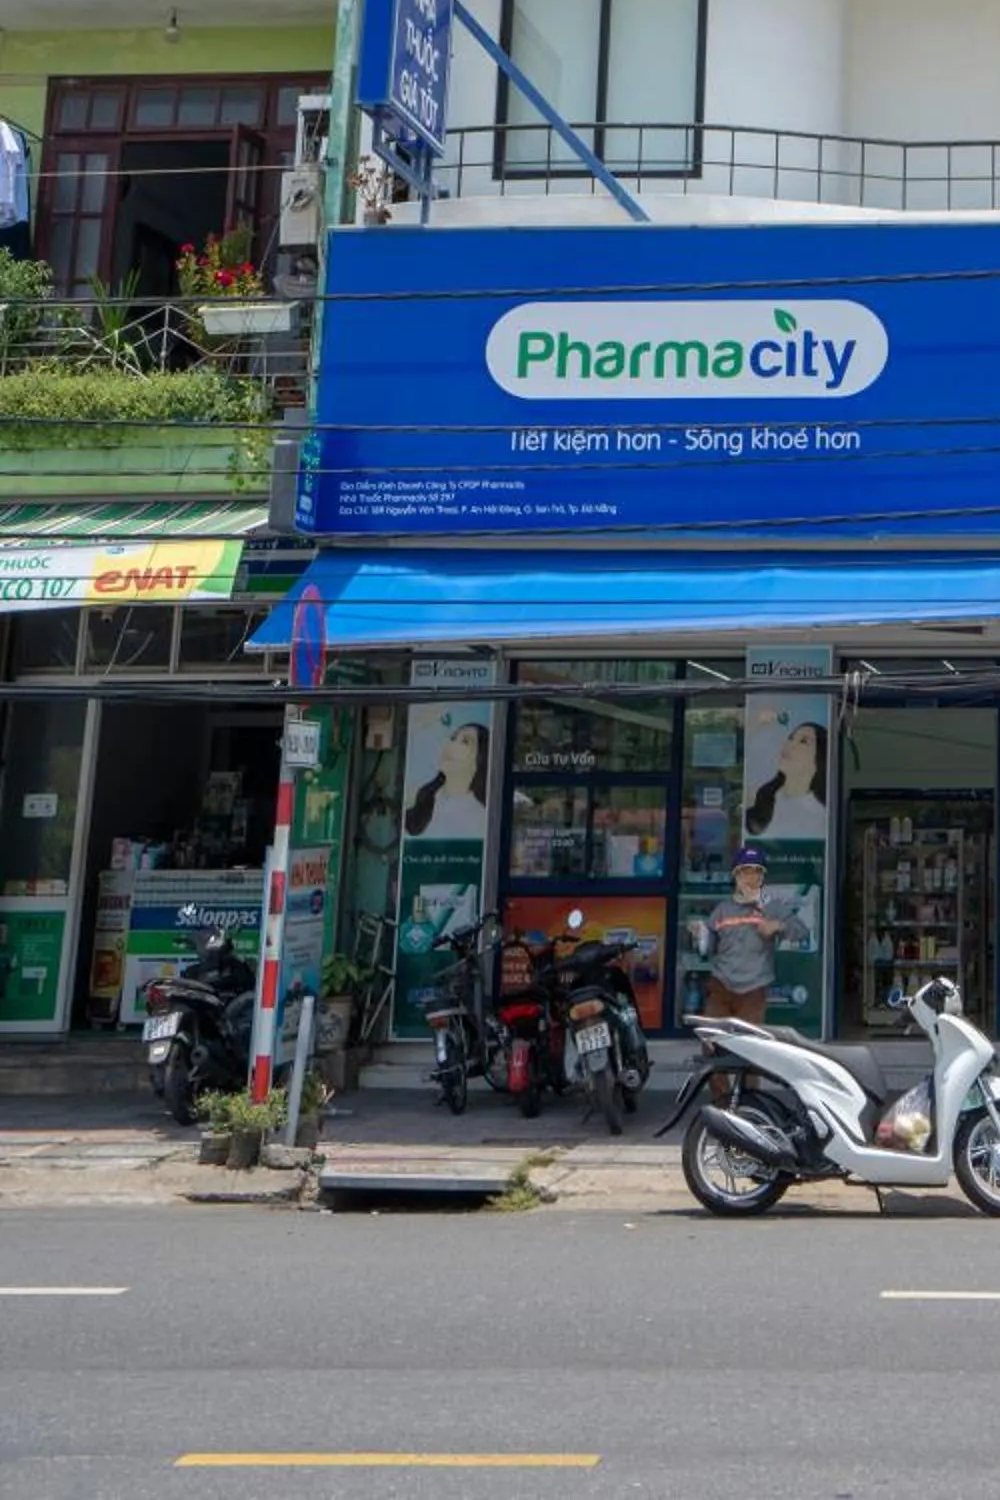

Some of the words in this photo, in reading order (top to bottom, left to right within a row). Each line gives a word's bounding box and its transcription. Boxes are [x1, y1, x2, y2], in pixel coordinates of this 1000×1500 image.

[405, 18, 439, 81] THUỐC
[400, 69, 418, 112] GIÁ
[420, 82, 439, 131] TỐT
[516, 328, 857, 389] Pharmacity
[554, 428, 610, 455] kiệm
[617, 429, 661, 451] hơn
[815, 427, 861, 450] hơn
[0, 578, 33, 599] CO
[40, 578, 77, 598] 107
[175, 905, 259, 930] Salonpas
